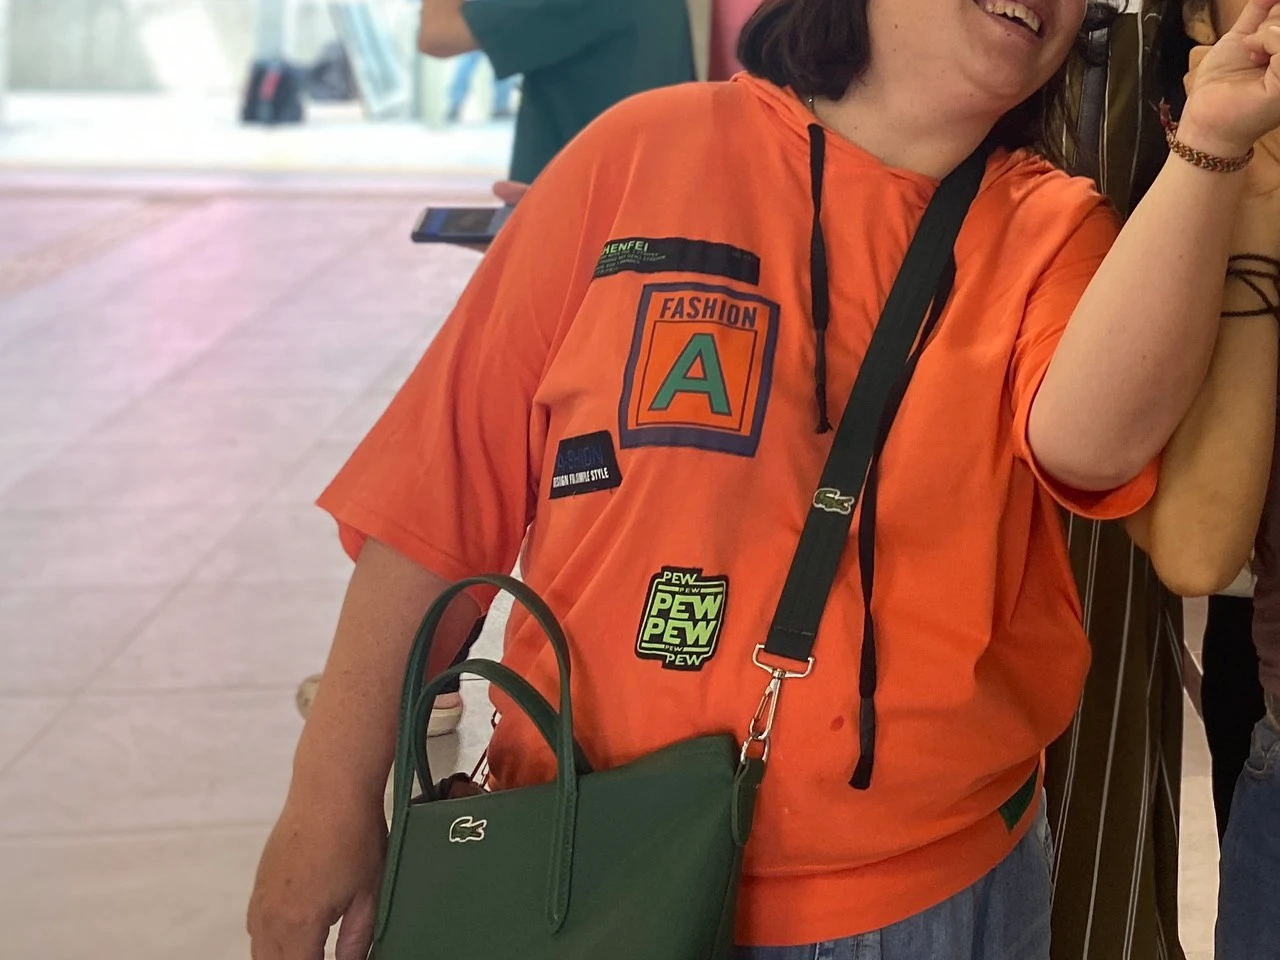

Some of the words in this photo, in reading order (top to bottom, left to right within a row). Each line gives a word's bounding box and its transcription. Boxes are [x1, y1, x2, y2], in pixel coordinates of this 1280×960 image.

[659, 296, 758, 328] FASHION
[648, 332, 733, 417] A
[590, 467, 609, 481] STYLE
[663, 571, 698, 585] PEW
[651, 592, 723, 620] PEW
[643, 617, 717, 646] PEW
[666, 654, 703, 666] PEW
